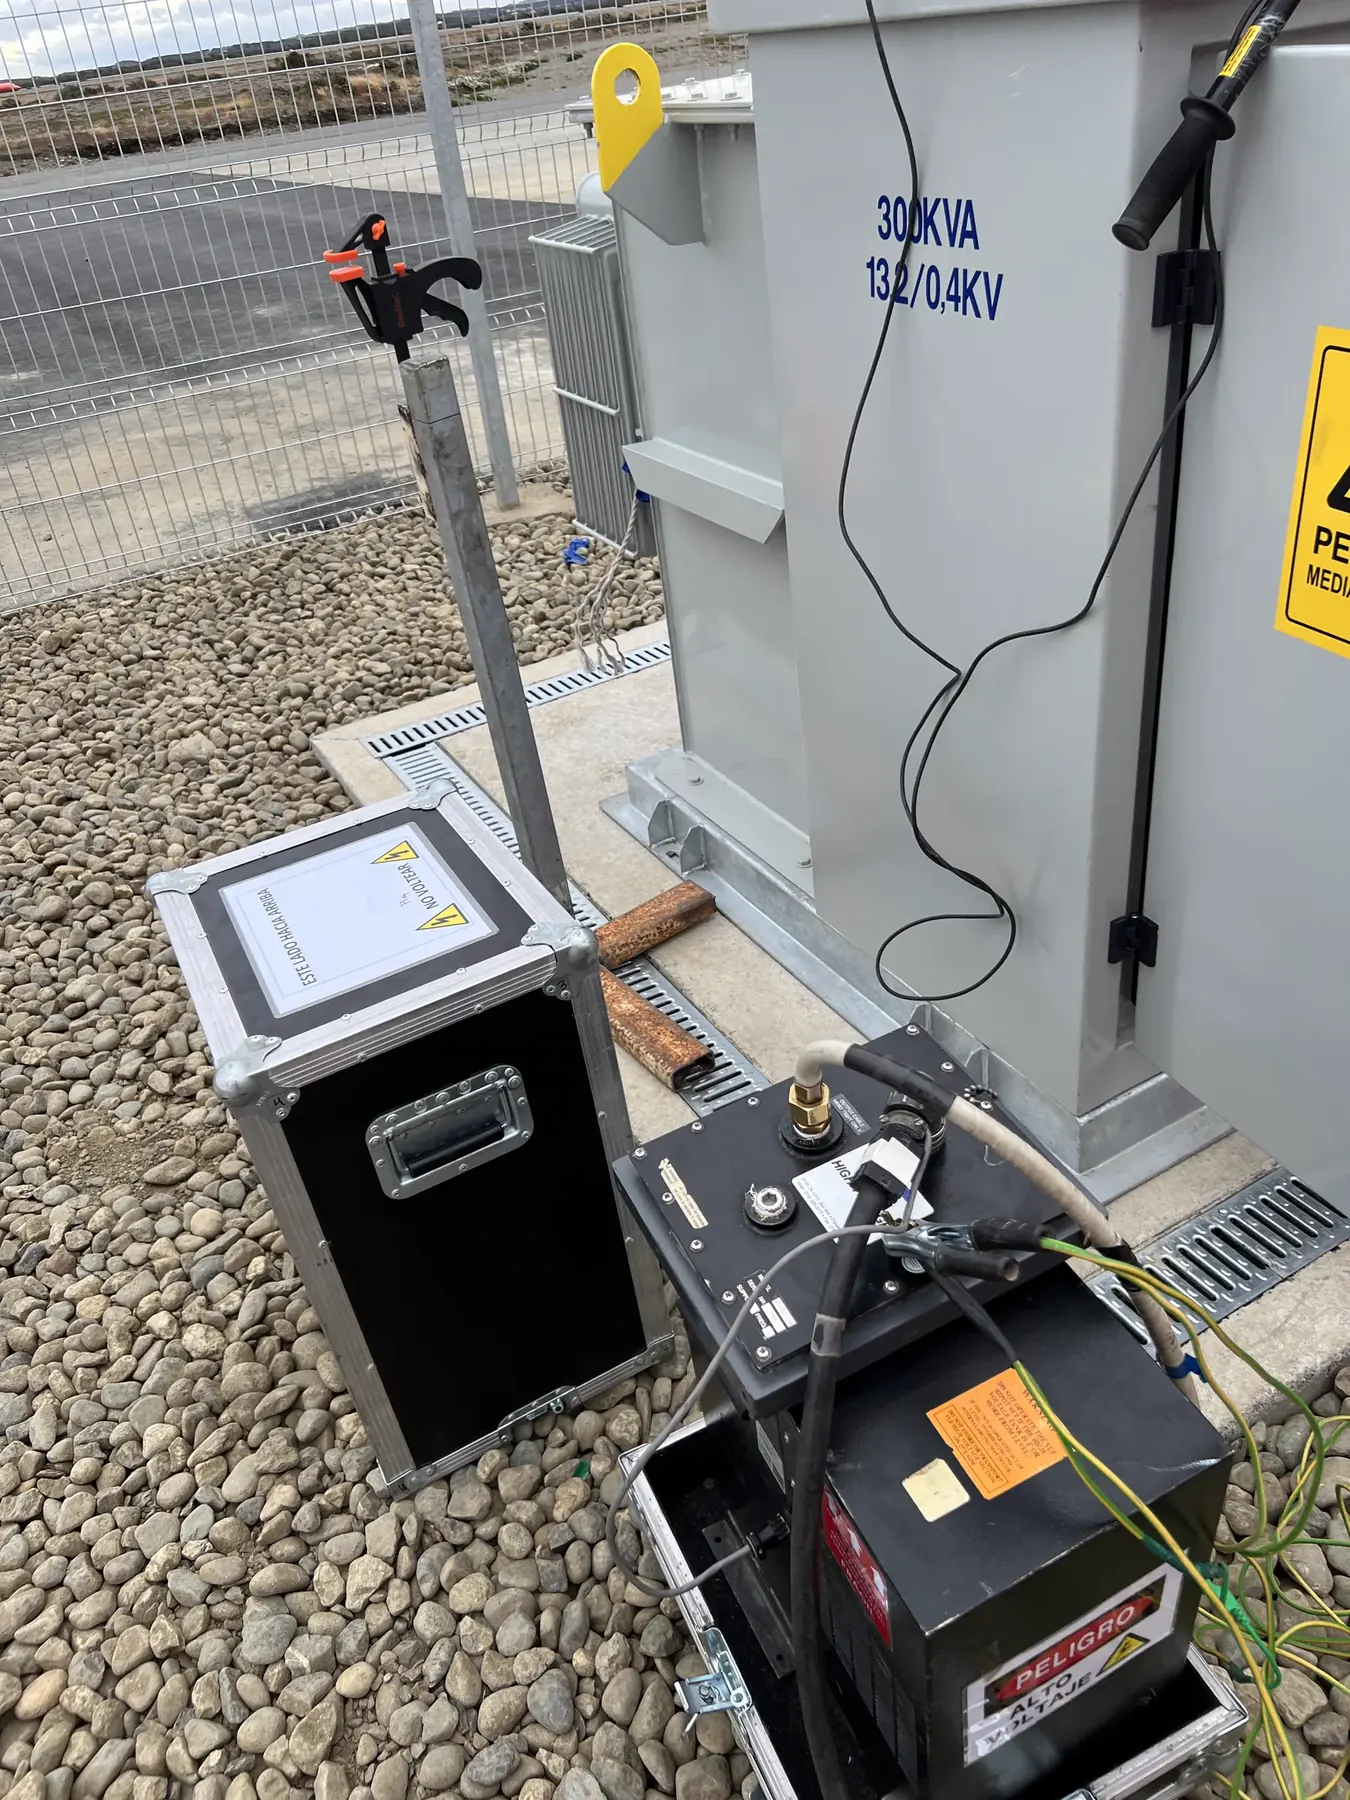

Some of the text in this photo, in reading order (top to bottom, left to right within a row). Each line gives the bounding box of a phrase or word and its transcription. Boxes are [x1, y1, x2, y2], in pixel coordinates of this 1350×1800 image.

[877, 195, 979, 250] 300KVA
[397, 862, 439, 910] NO VOLTEAR
[257, 887, 317, 987] ESTE LADO HACIA ARRIBA
[1016, 1605, 1135, 1690] PELIGRO
[1009, 1672, 1072, 1719] ALTO
